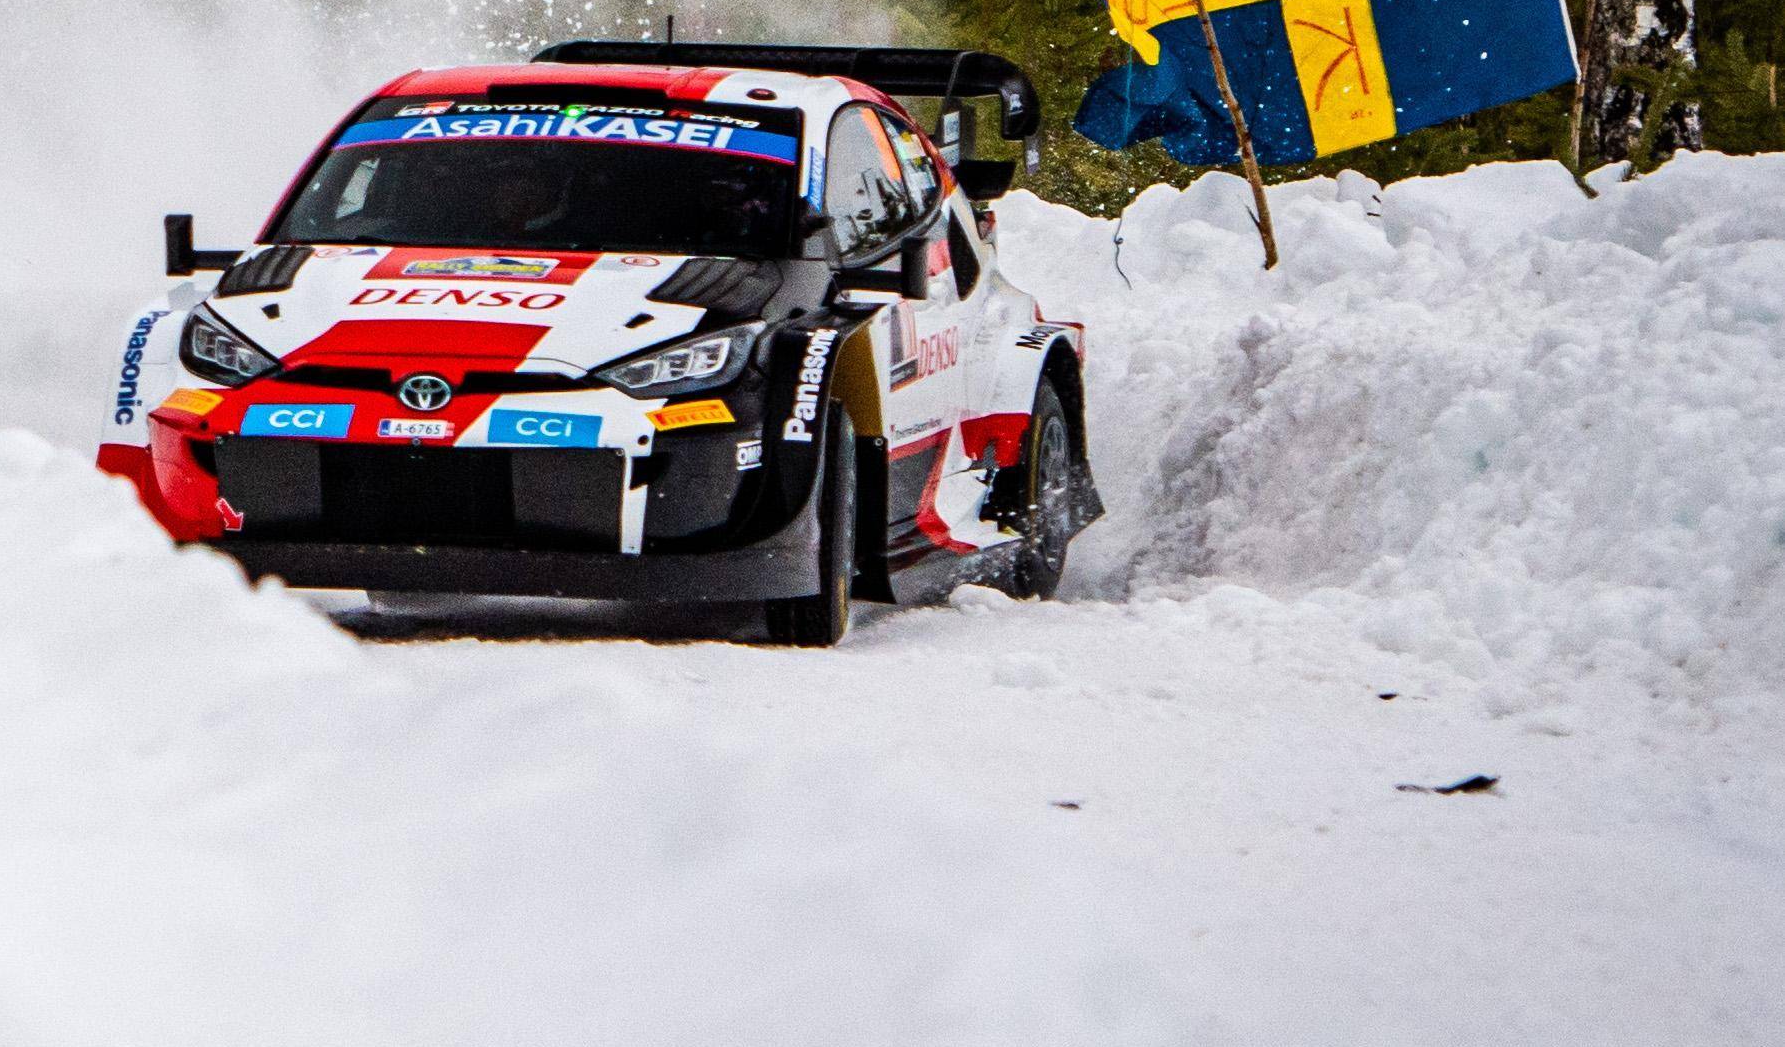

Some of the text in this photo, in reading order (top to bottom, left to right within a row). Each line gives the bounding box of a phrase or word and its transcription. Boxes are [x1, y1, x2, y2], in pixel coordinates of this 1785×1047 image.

[457, 104, 560, 113] TOYOTA
[349, 288, 567, 310] DENSO
[115, 310, 172, 425] Panasonic
[917, 325, 959, 379] DENSO
